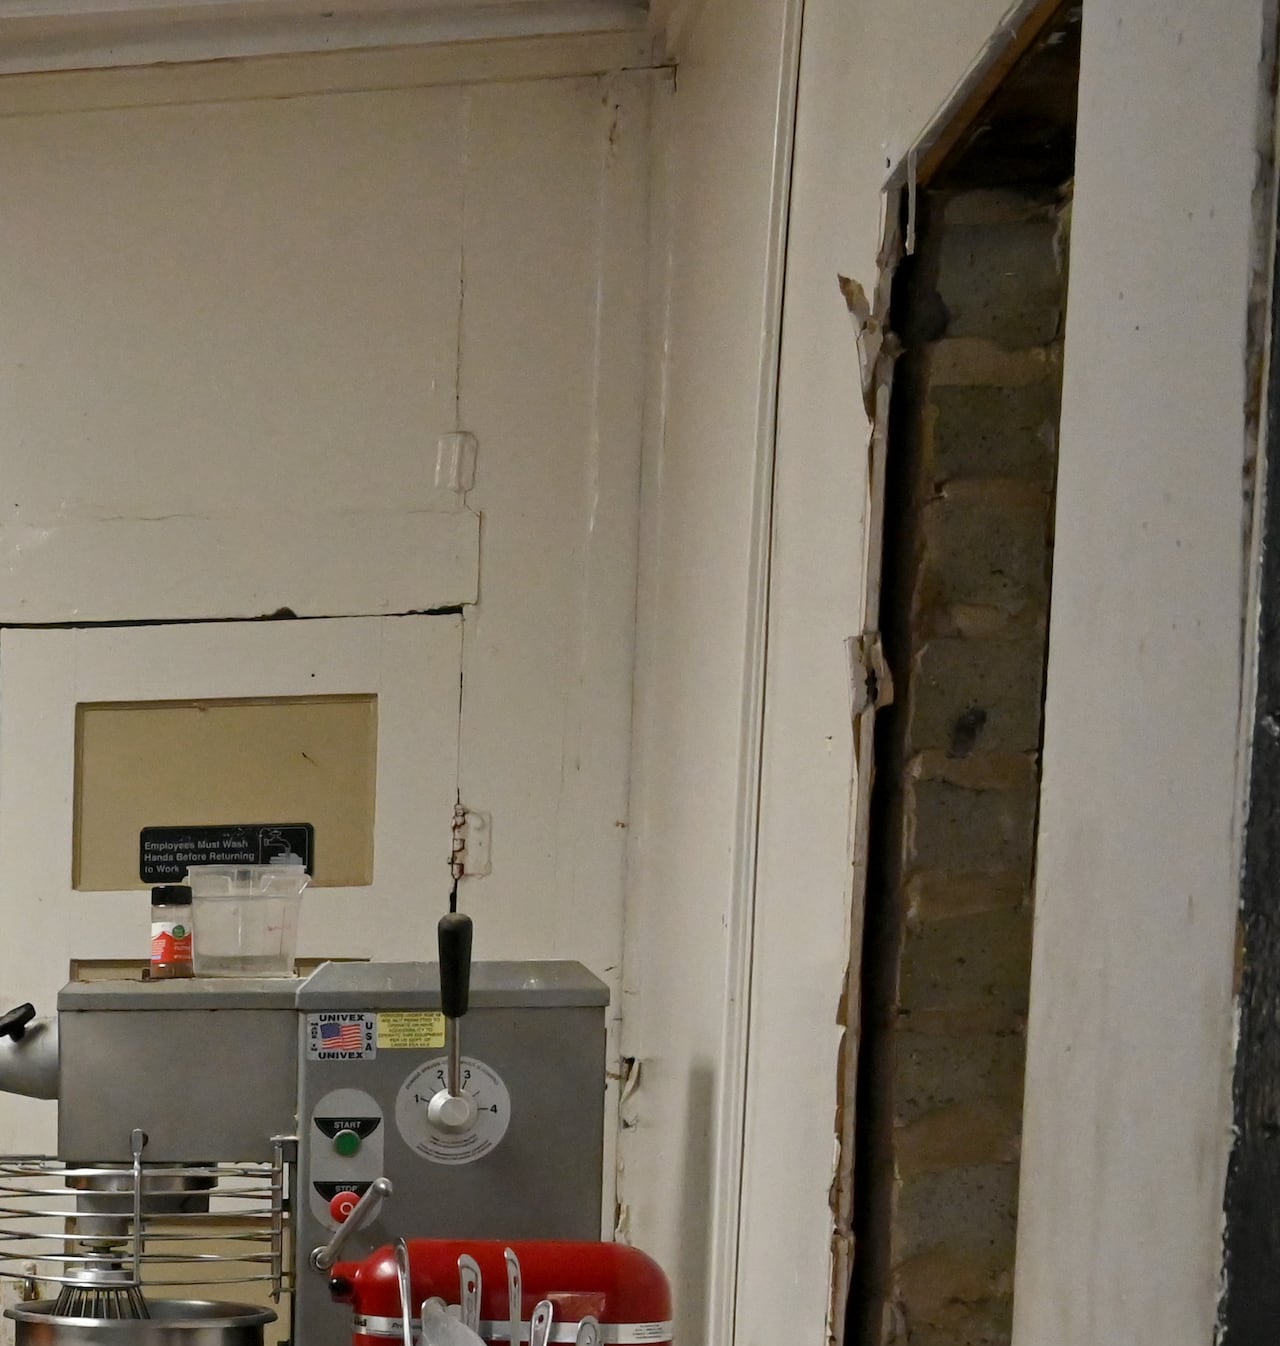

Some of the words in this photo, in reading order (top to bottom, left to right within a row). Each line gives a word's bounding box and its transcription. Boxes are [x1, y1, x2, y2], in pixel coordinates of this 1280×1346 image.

[144, 842, 195, 852] Employees
[197, 840, 220, 848] Must
[223, 840, 249, 848] Wash
[144, 853, 174, 862] Hands
[176, 852, 207, 861] Before
[209, 852, 255, 862] Returning
[156, 865, 179, 873] Work
[319, 1014, 365, 1022] UNIVEX
[318, 1052, 364, 1060] UNIVEX
[436, 1070, 444, 1080] 2
[464, 1070, 471, 1079] 3
[414, 1094, 419, 1102] 1
[490, 1104, 498, 1114] 4
